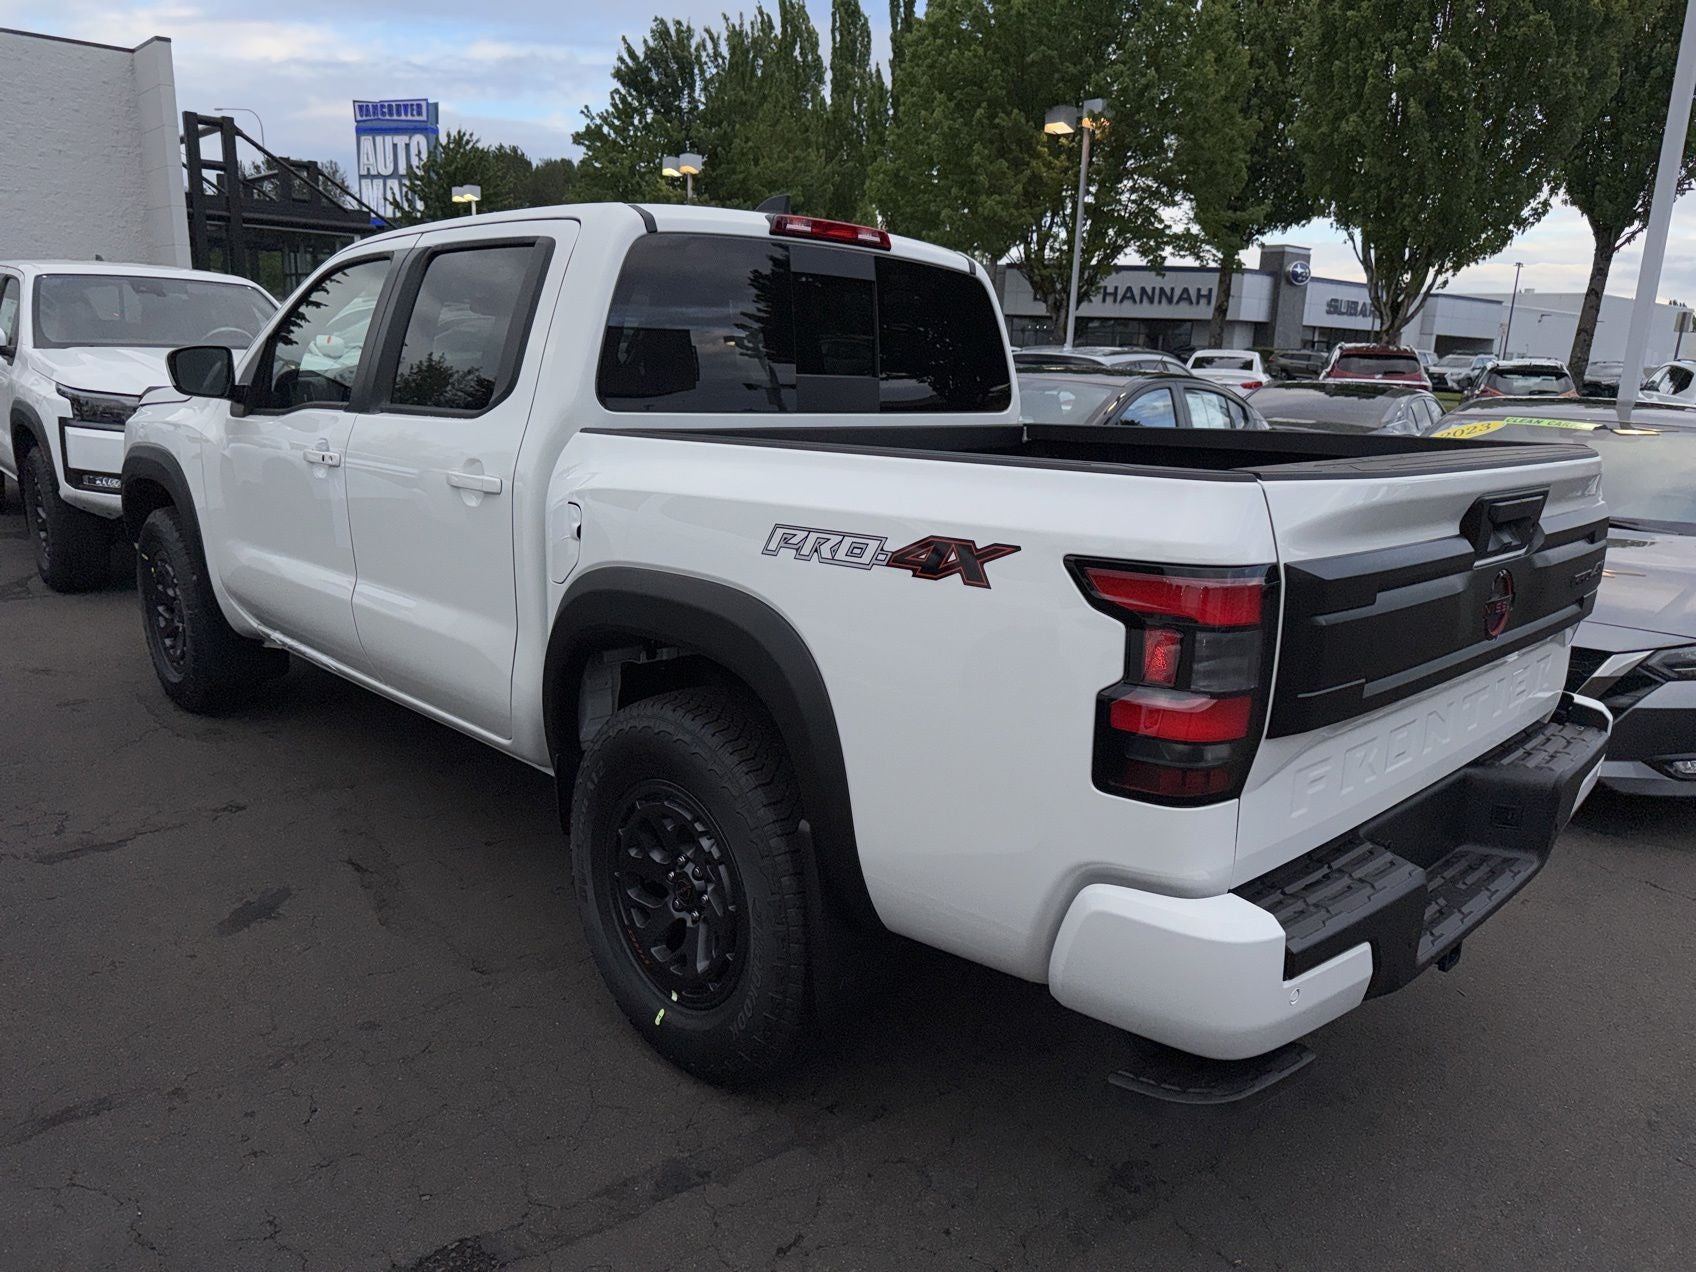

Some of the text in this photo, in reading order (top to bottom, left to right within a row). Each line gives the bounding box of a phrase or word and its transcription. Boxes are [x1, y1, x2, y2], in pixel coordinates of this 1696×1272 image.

[357, 103, 423, 118] VANCOUVER
[359, 134, 428, 176] AUTO
[1102, 285, 1213, 306] HANNAH
[1326, 298, 1373, 318] SUBA
[1290, 652, 1553, 818] FRONTIER
